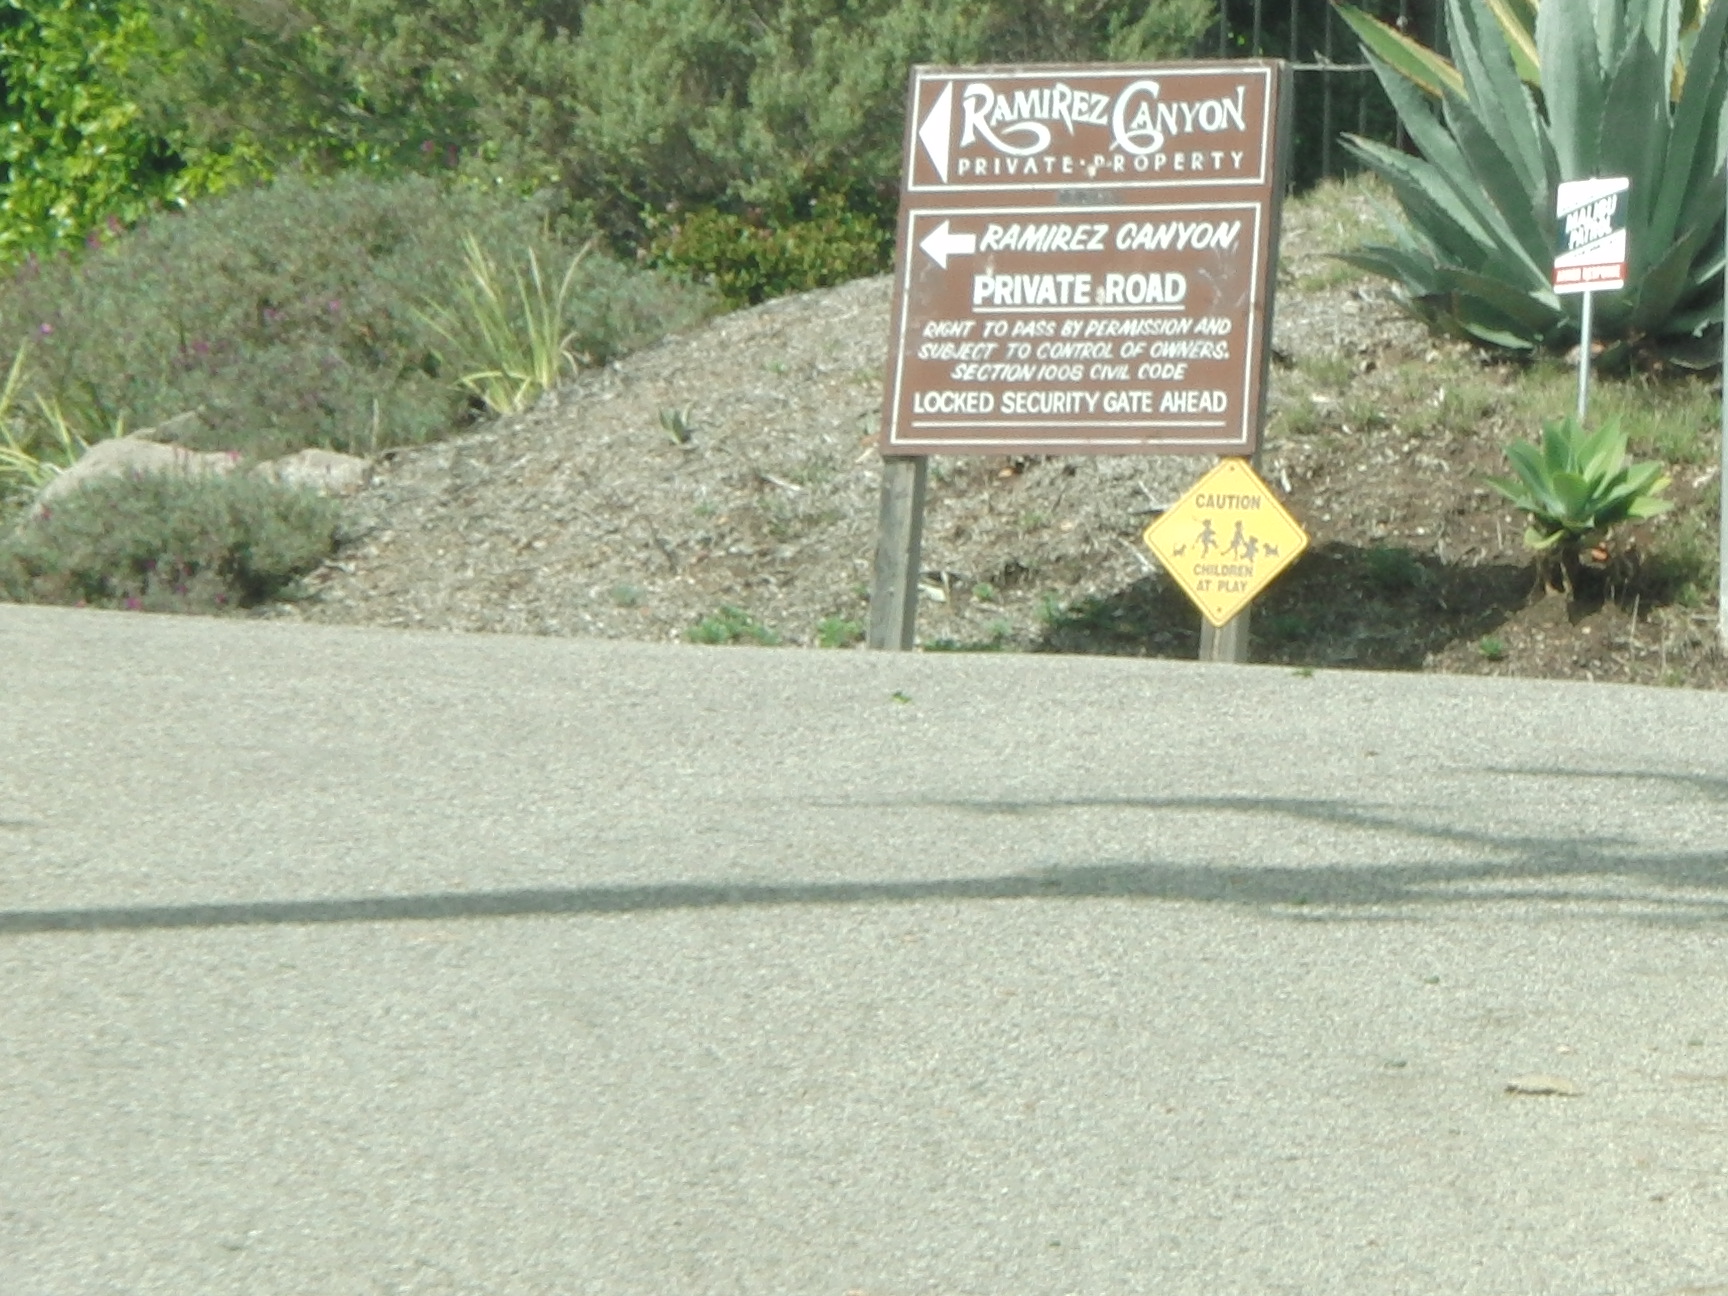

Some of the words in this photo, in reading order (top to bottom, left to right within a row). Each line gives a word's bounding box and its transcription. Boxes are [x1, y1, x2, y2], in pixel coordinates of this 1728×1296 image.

[960, 82, 1110, 156] RAMIREZ
[1110, 80, 1246, 154] CANYON
[958, 156, 1073, 176] PRIVATE
[1094, 151, 1245, 172] PROPERTY
[979, 224, 1110, 252] RAMIREZ
[1116, 220, 1241, 250] CANYON
[973, 274, 1091, 305] PRIVATE
[1105, 272, 1186, 304] ROAD
[922, 320, 975, 339] RIGHT
[982, 320, 1008, 338] TO
[1010, 320, 1056, 337] PASS
[1061, 320, 1082, 337] BY
[1083, 318, 1191, 337] PERMISSION
[1194, 317, 1232, 336] AND
[919, 342, 999, 360] SUBJECT
[1007, 342, 1031, 359] TO
[1036, 341, 1113, 359] CONTROL
[1120, 340, 1148, 359] OF
[950, 364, 1036, 382] SECTION
[1089, 363, 1131, 381] CIVIL
[1137, 362, 1188, 380] CODE
[914, 391, 995, 414] LOCKED
[1001, 391, 1100, 414] SECURITY
[1103, 391, 1153, 413] GATE
[1160, 390, 1227, 413] AHEAD
[1195, 494, 1261, 509] CAUTION
[1193, 563, 1253, 577] CHILDREN
[1197, 580, 1211, 592] AT
[1218, 580, 1247, 593] PLAY
